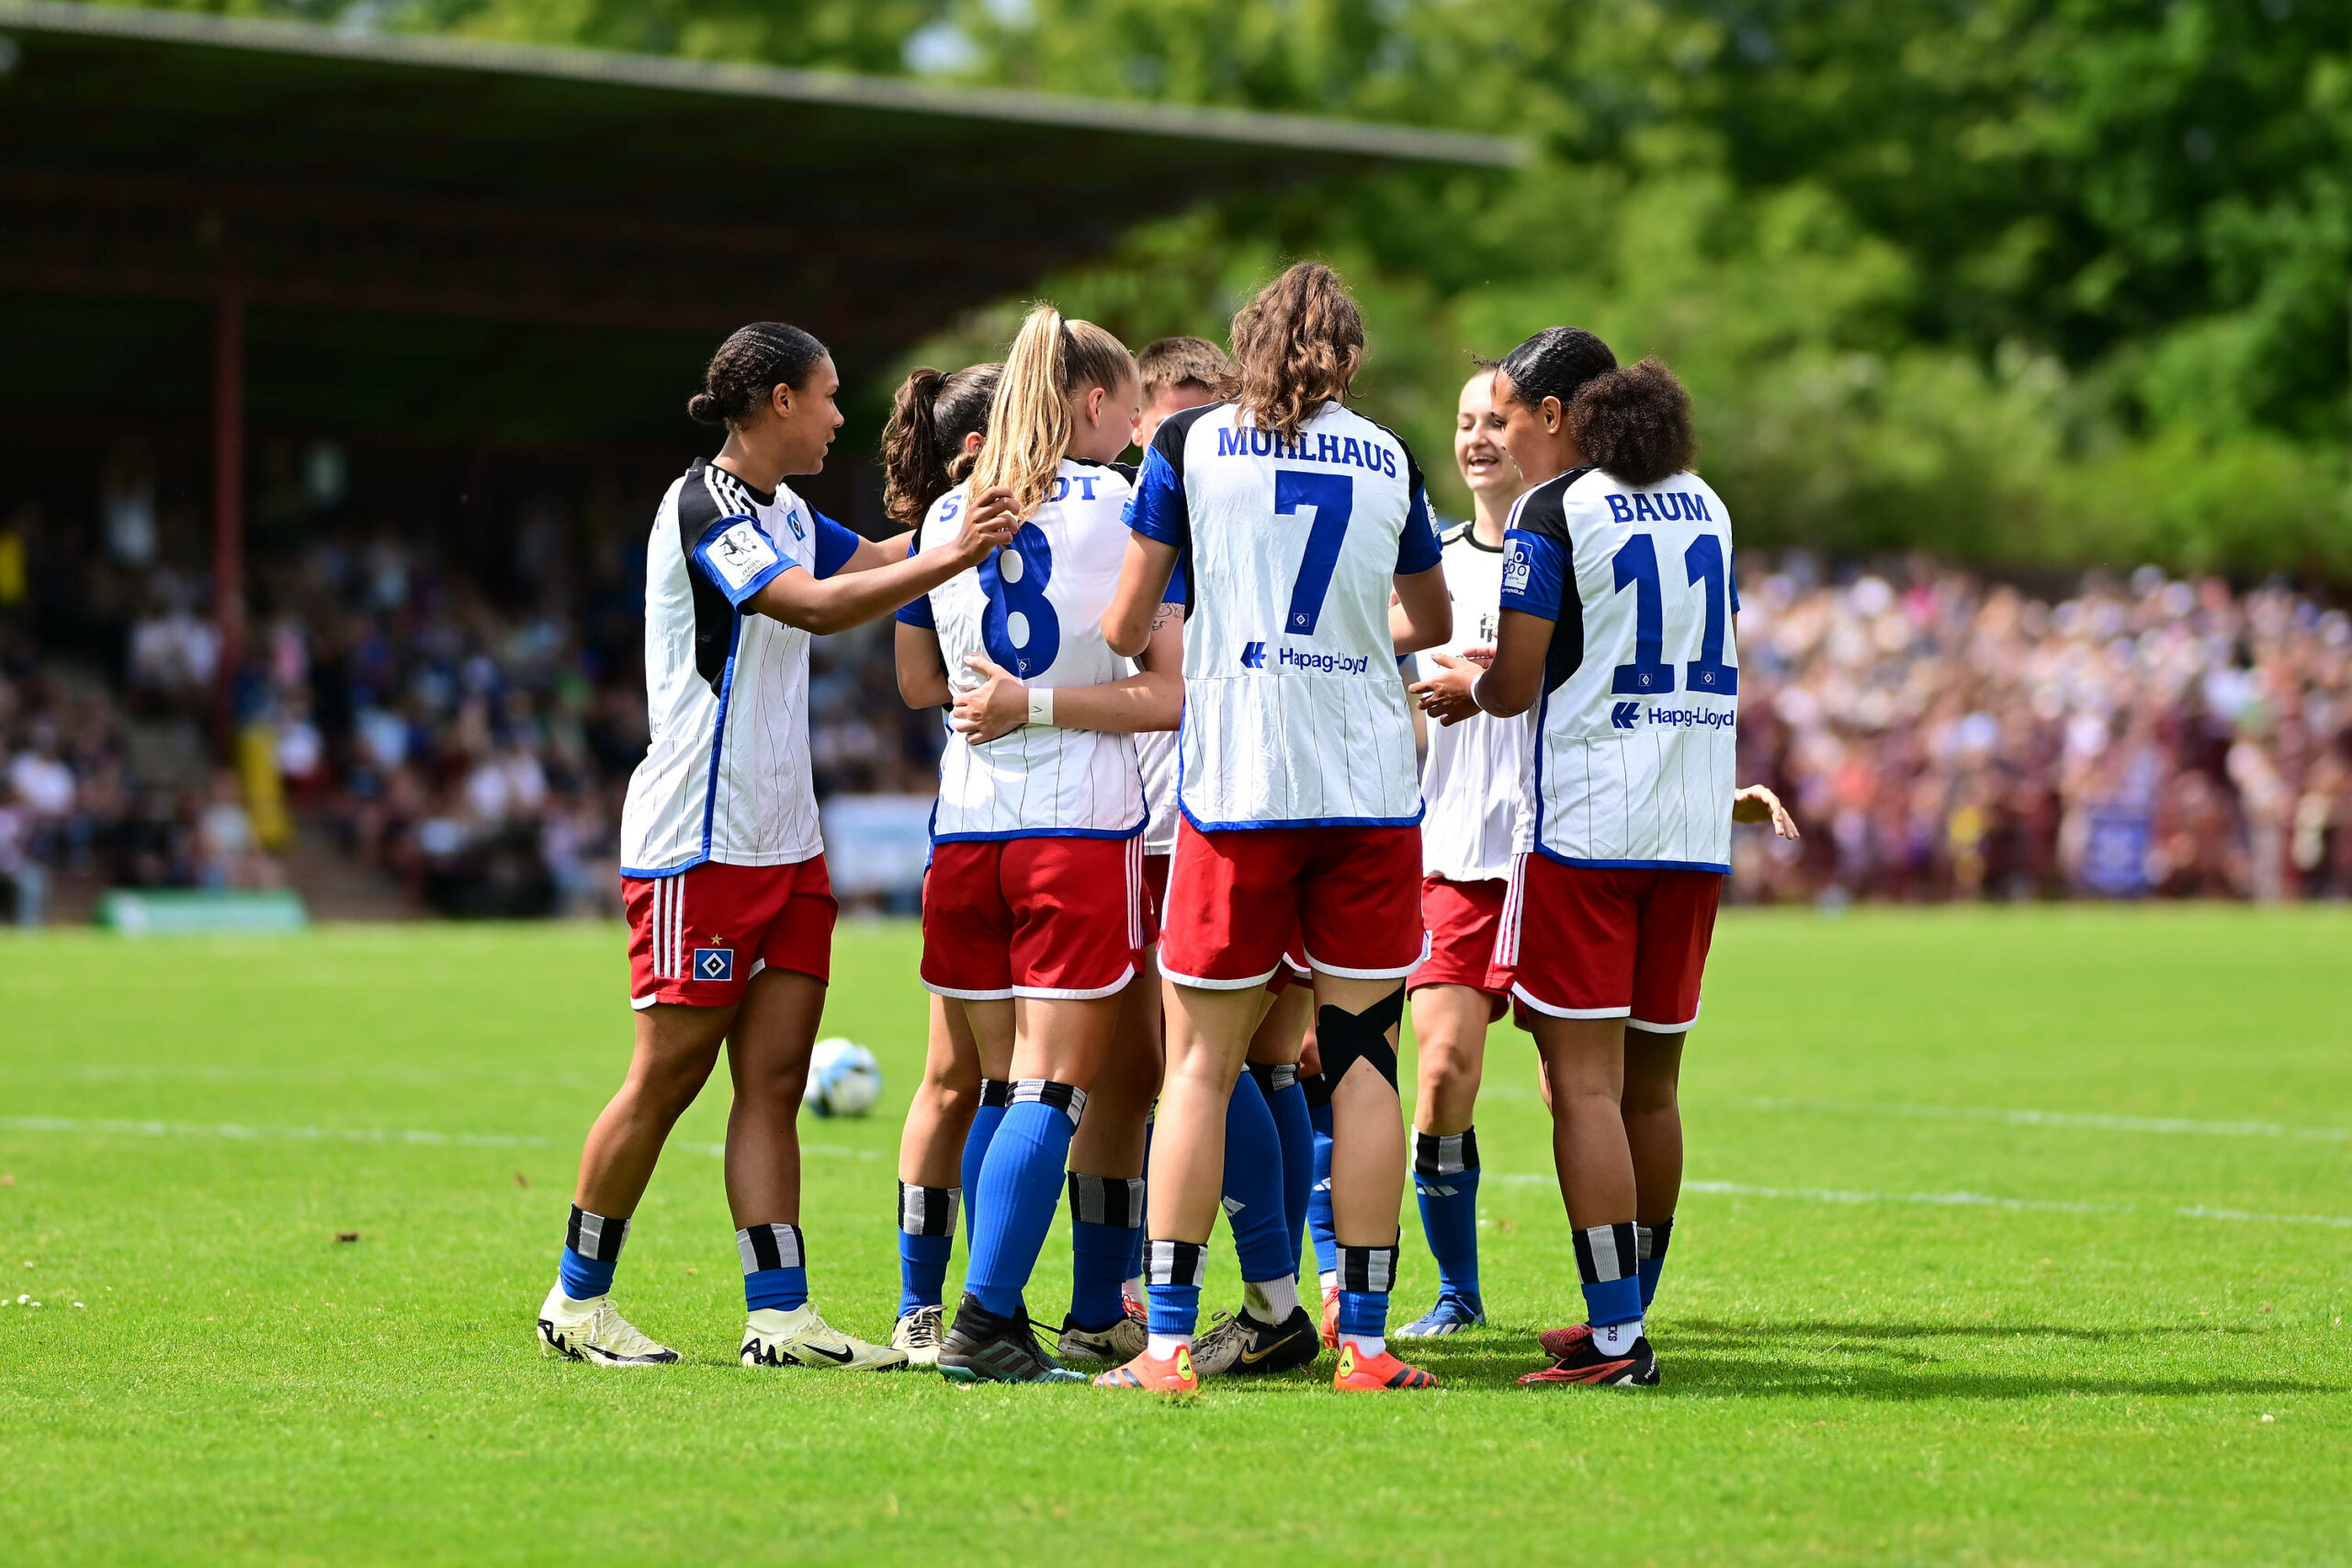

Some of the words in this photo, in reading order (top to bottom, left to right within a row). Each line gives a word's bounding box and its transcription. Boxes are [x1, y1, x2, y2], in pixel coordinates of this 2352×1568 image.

[1274, 469, 1353, 636] 7
[1604, 491, 1713, 524] BAUM
[977, 521, 1060, 680] 8
[1279, 648, 1368, 675] Hapag-Lloyd
[1611, 533, 1738, 695] 11
